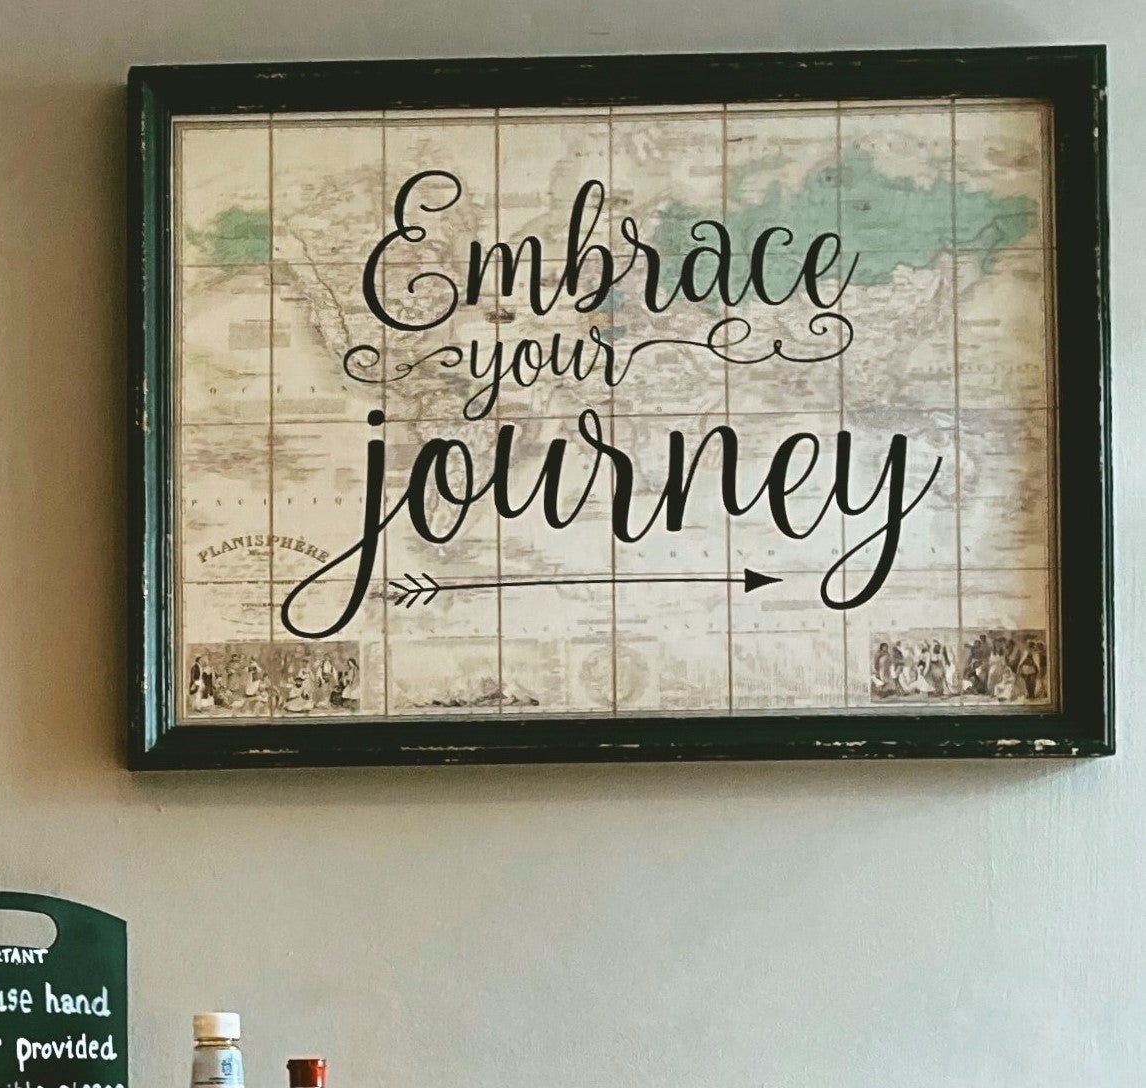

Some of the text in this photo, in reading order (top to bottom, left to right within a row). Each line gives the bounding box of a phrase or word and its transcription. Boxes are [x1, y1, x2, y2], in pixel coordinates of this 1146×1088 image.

[362, 169, 860, 332] Embrace
[280, 408, 943, 639] journey
[197, 533, 331, 564] PLANISPHÈRE
[45, 982, 112, 1017] hand
[16, 1032, 118, 1072] provided
